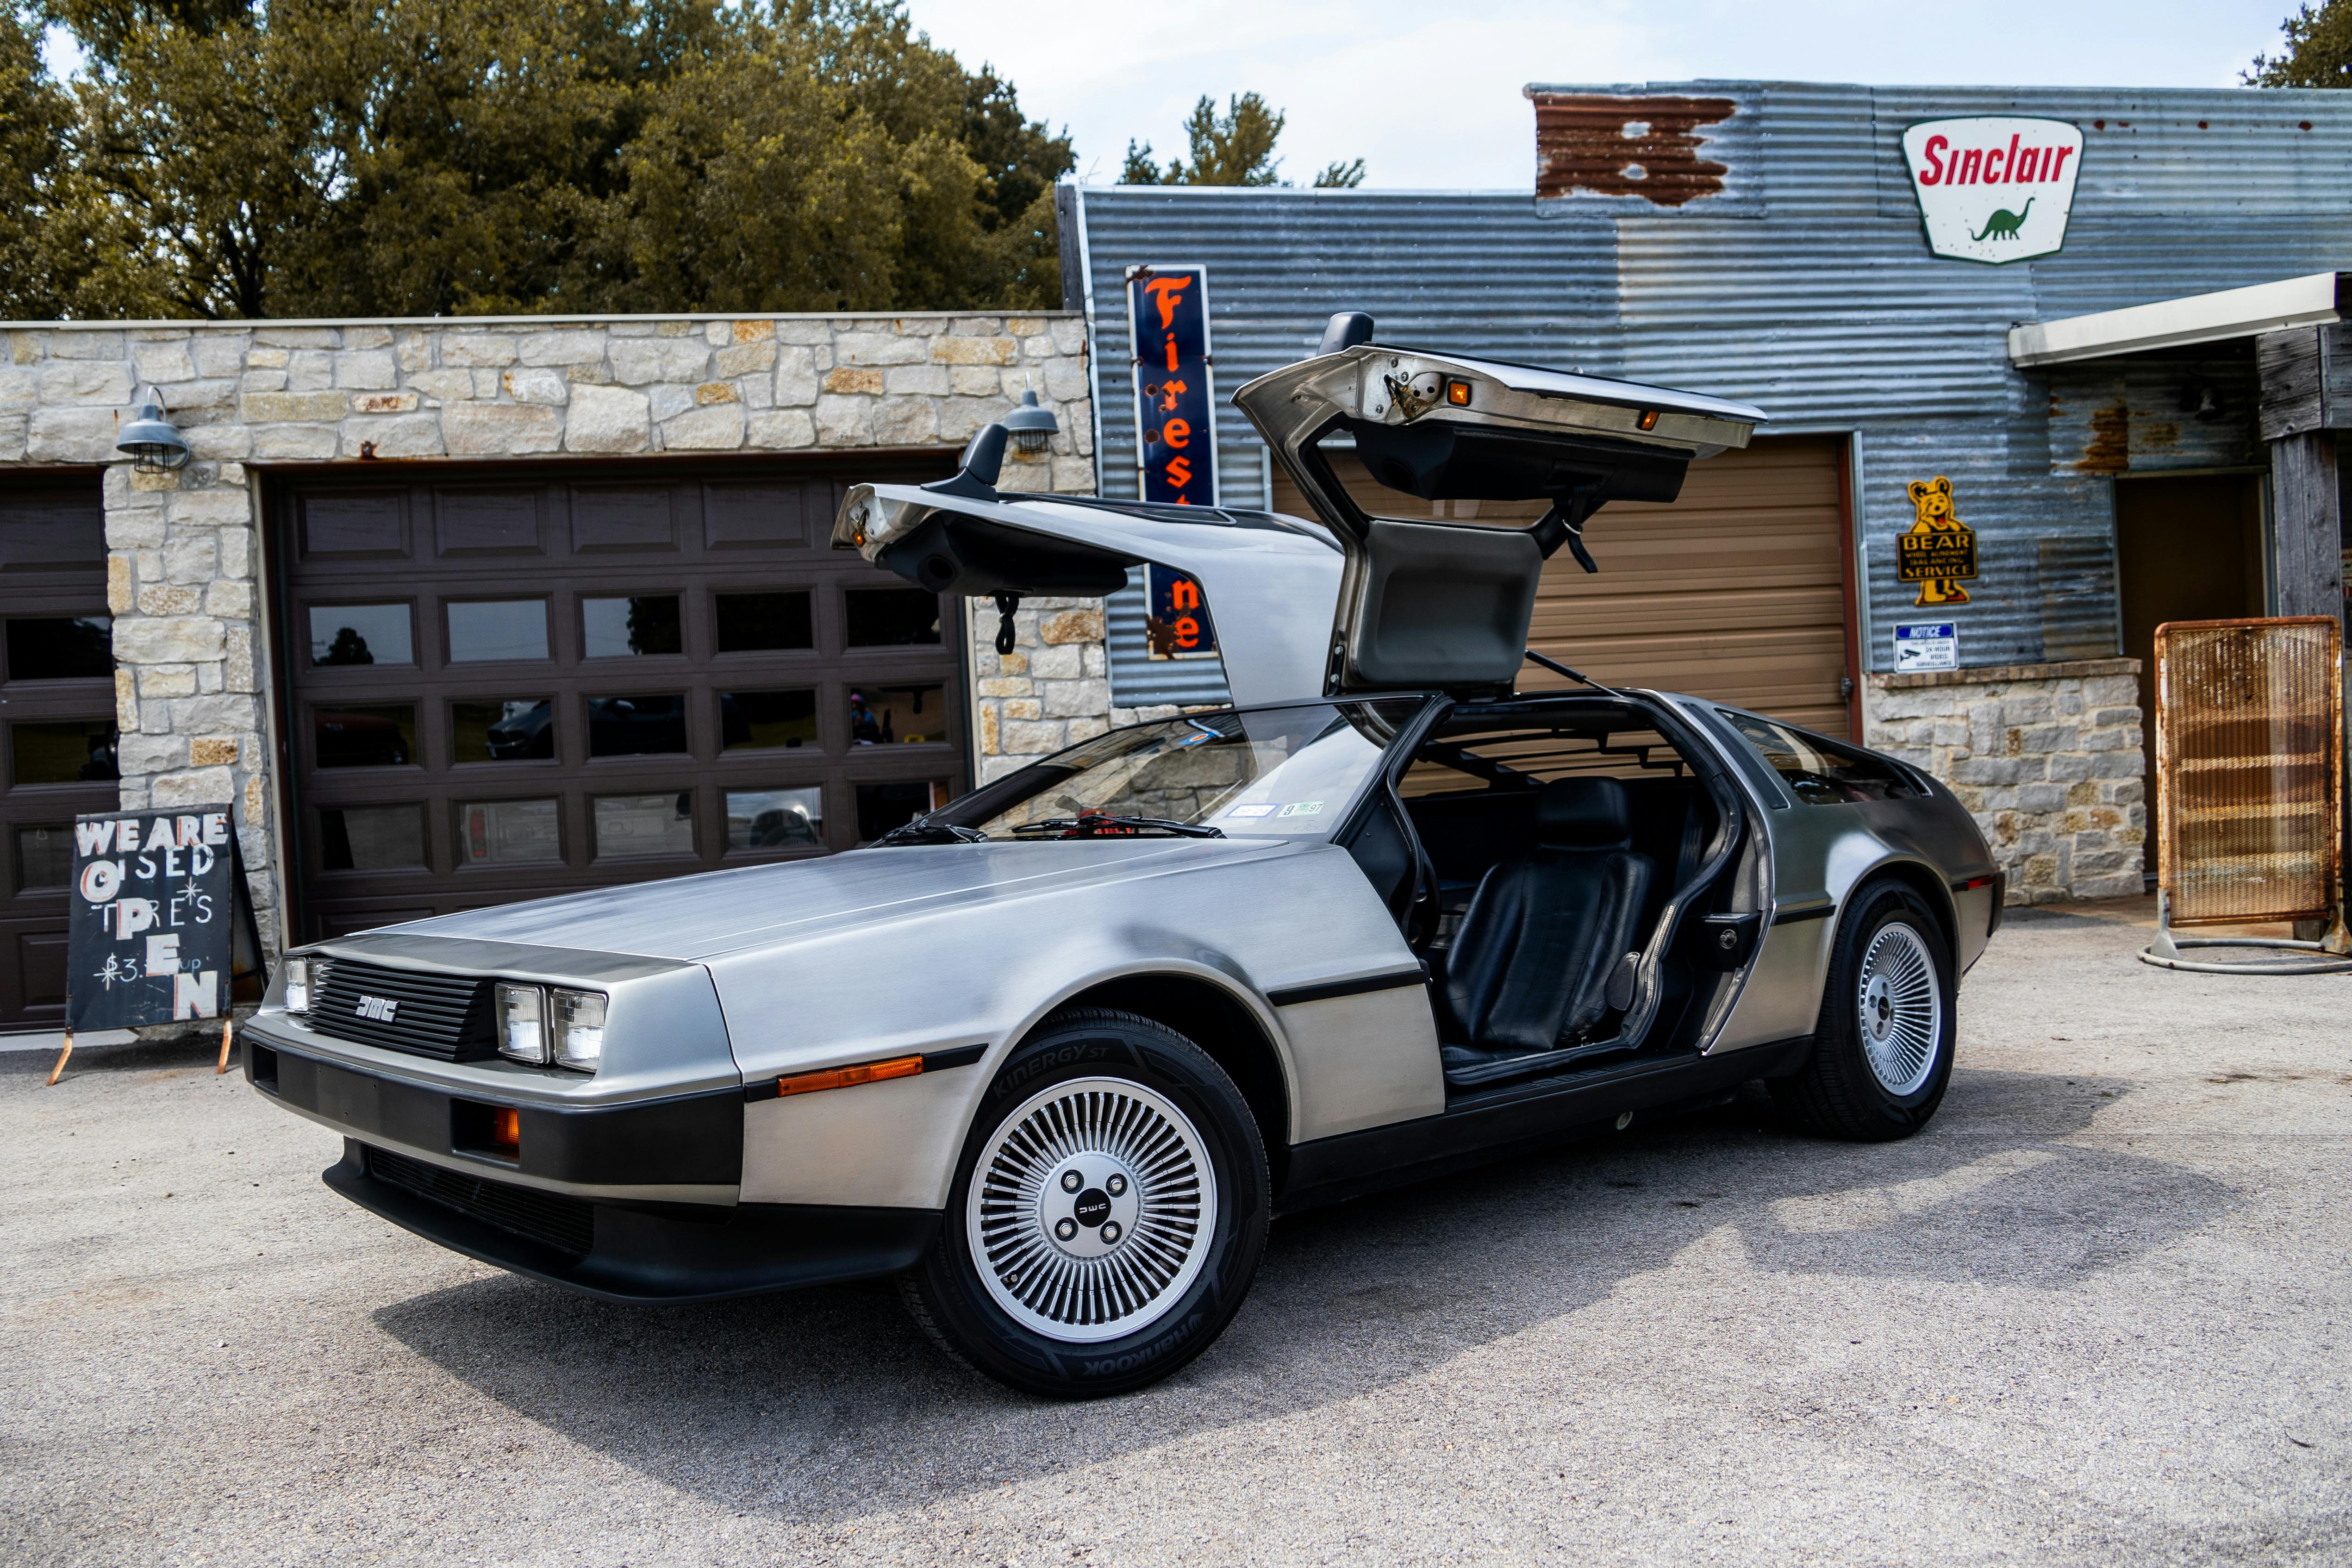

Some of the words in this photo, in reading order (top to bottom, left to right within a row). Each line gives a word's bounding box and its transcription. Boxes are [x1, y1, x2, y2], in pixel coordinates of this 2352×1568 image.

[1919, 133, 2073, 187] Sinclair
[1145, 275, 1200, 648] Firesne
[1903, 534, 1970, 550] BEAR
[1905, 564, 1971, 577] SERVICE
[1909, 626, 1942, 638] NOTICE
[1284, 805, 1295, 815] 9
[1309, 804, 1323, 812] 97
[76, 819, 140, 857] WE
[145, 812, 229, 851] ARE
[356, 995, 399, 1023] DMC
[993, 1044, 1087, 1100] KINERGY
[1088, 1047, 1109, 1058] ST
